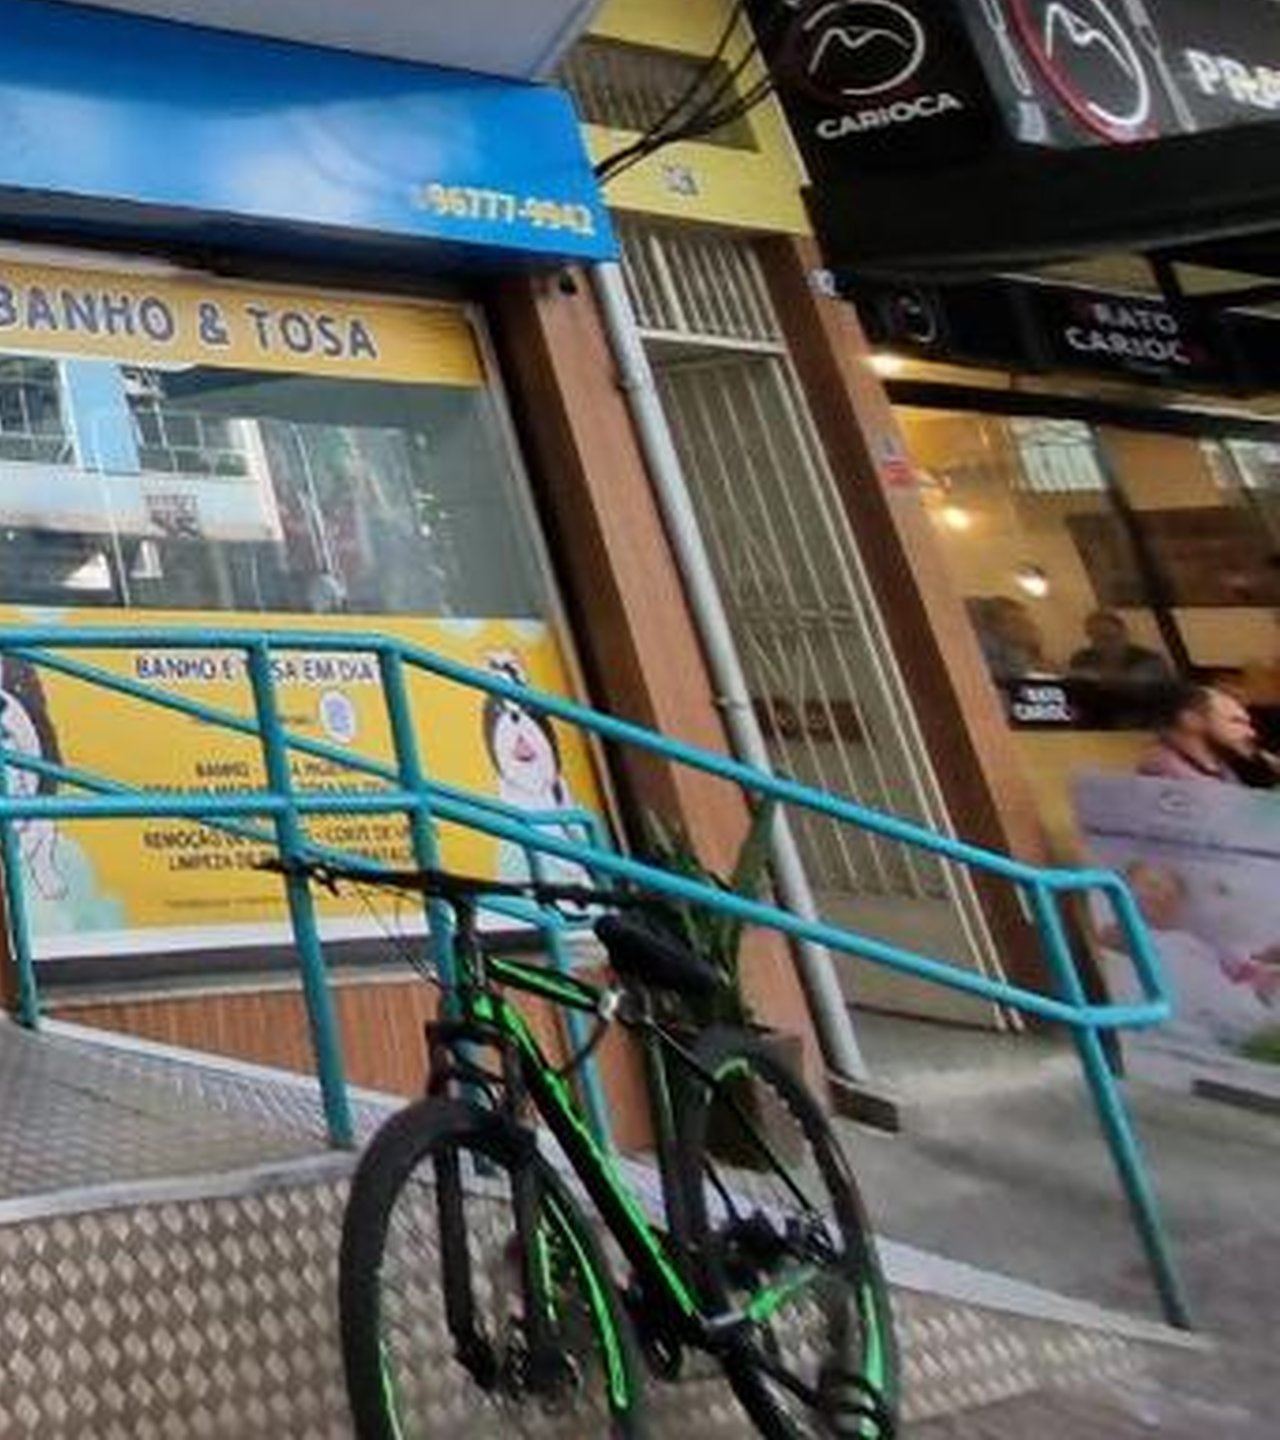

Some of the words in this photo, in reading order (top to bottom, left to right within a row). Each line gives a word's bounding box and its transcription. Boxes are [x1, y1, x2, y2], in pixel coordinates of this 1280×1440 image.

[816, 93, 963, 139] CARIOCA
[197, 302, 229, 345] &
[246, 306, 378, 360] TOSA
[136, 658, 217, 680] BANHO
